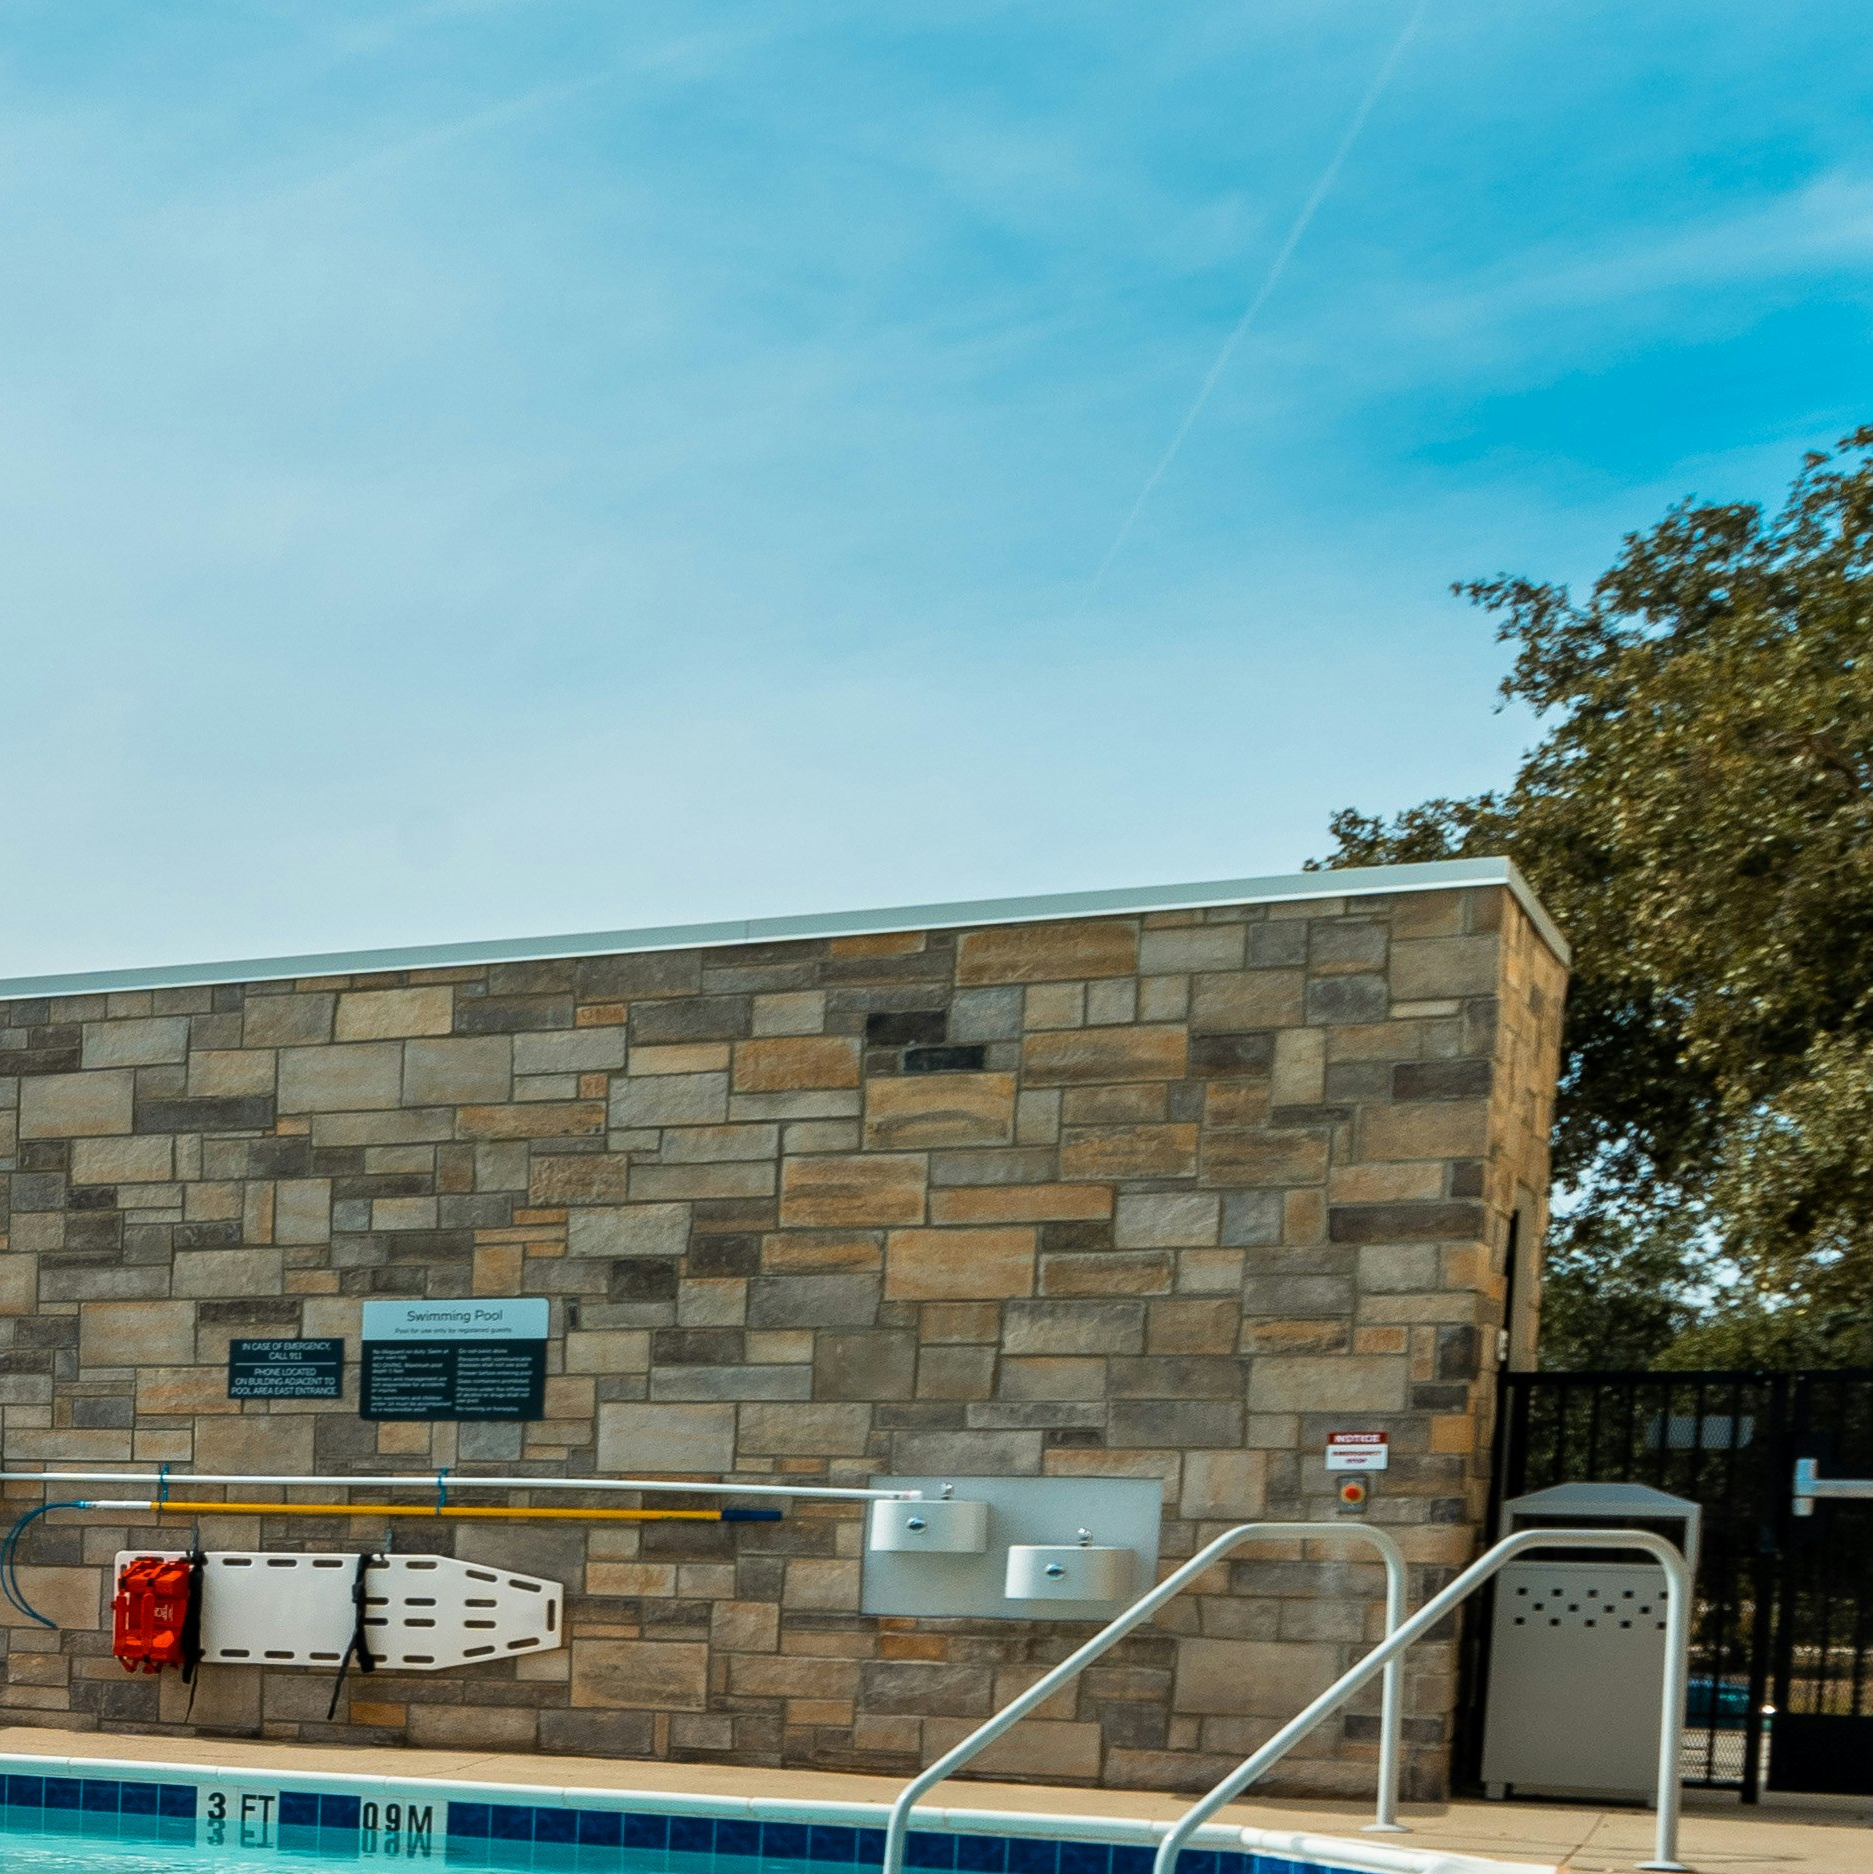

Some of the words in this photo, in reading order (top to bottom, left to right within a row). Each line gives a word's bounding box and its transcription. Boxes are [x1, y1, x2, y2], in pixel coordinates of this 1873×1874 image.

[407, 1310, 471, 1323] Swimming
[474, 1310, 502, 1321] Pool
[242, 1343, 251, 1351] IN
[252, 1343, 271, 1351] CASE
[273, 1342, 283, 1351] OF
[269, 1352, 287, 1360] CALL
[289, 1352, 302, 1360] 911
[254, 1368, 280, 1376] PHONE
[282, 1367, 317, 1376] LOCATED
[235, 1377, 248, 1386] ON
[249, 1378, 283, 1386] BUILDING
[324, 1377, 336, 1386] TO
[231, 1387, 252, 1395] POOL
[253, 1387, 273, 1395] AREA
[274, 1386, 293, 1395] EAST
[208, 1792, 226, 1821] 3
[240, 1793, 276, 1823] FT
